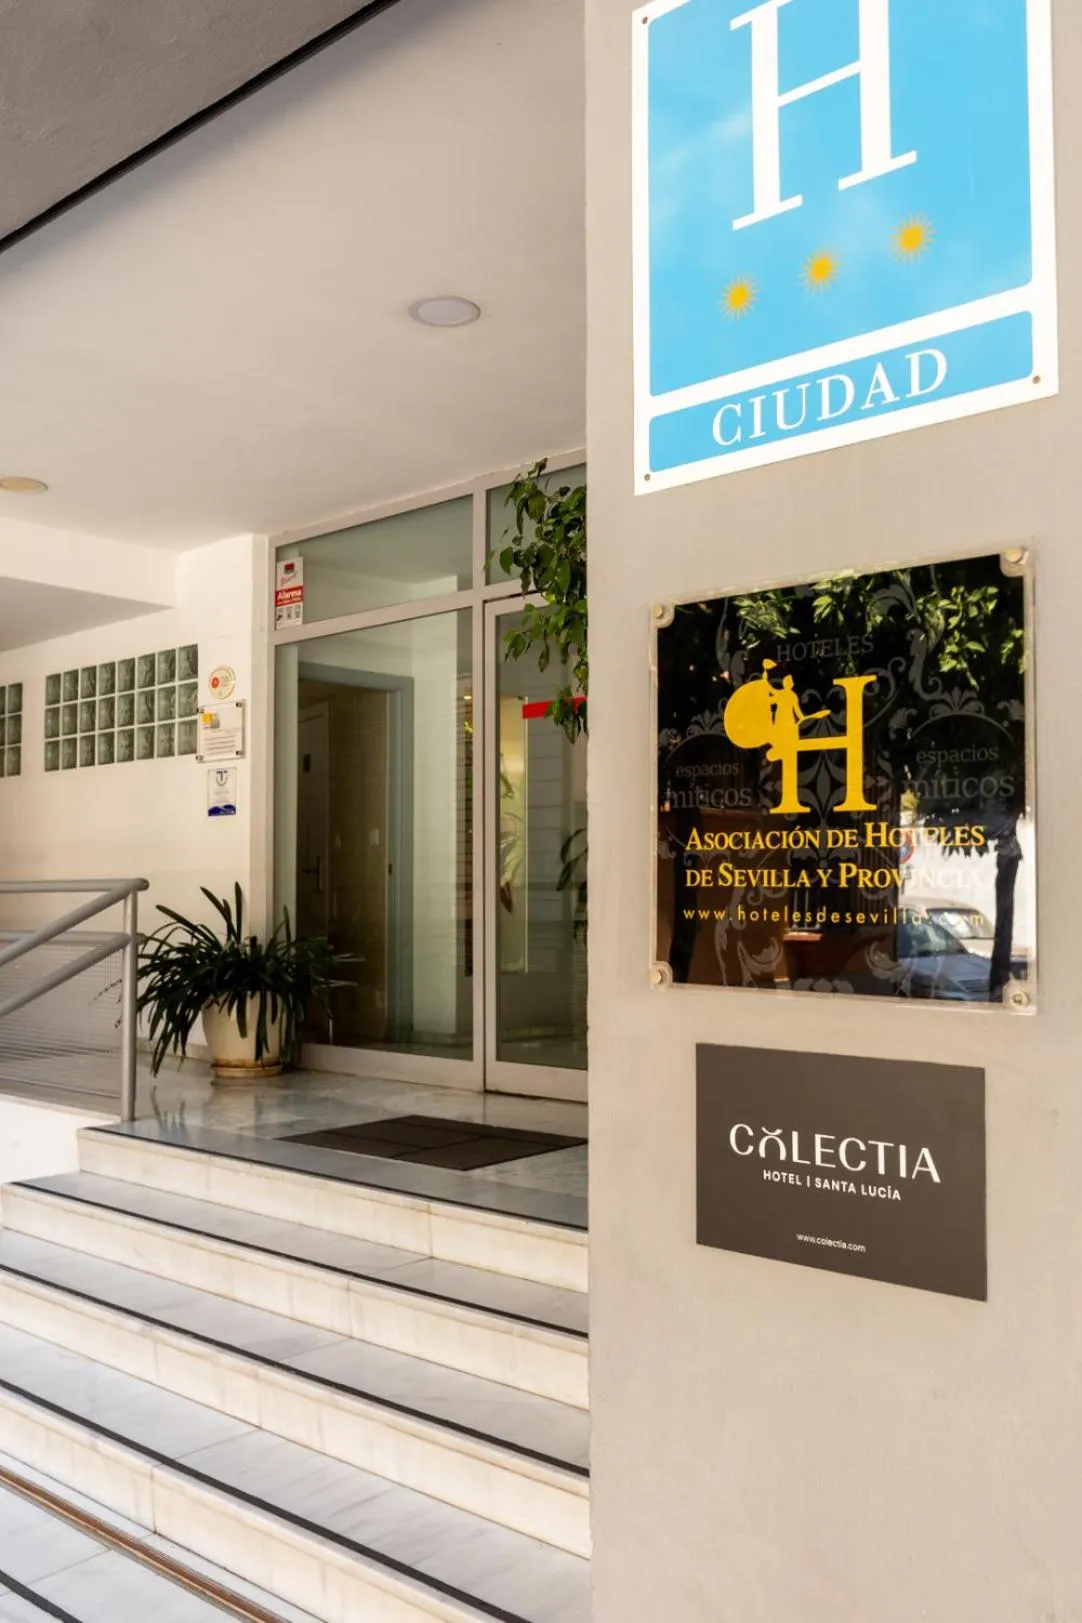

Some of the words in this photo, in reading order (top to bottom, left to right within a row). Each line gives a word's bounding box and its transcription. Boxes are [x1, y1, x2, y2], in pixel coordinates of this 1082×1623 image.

[729, 0, 918, 231] H
[712, 348, 948, 446] CIUDAD
[776, 634, 875, 663] HOTELES
[915, 744, 999, 768] espacios
[675, 761, 740, 780] espacios
[685, 825, 821, 851] ASOCIACIÓN
[827, 828, 859, 849] DE
[864, 821, 986, 848] HOTELES
[685, 869, 714, 888] DE
[718, 862, 811, 888] SEVILLA
[816, 868, 833, 888] Y
[838, 861, 981, 889] PROVINCIA
[683, 903, 985, 926] www.hotelesdesevilla.cm
[763, 1169, 802, 1186] HOTEL
[815, 1177, 857, 1194] SANTA
[861, 1183, 902, 1201] LUCÍA
[796, 1233, 867, 1252] www.colectia.com
